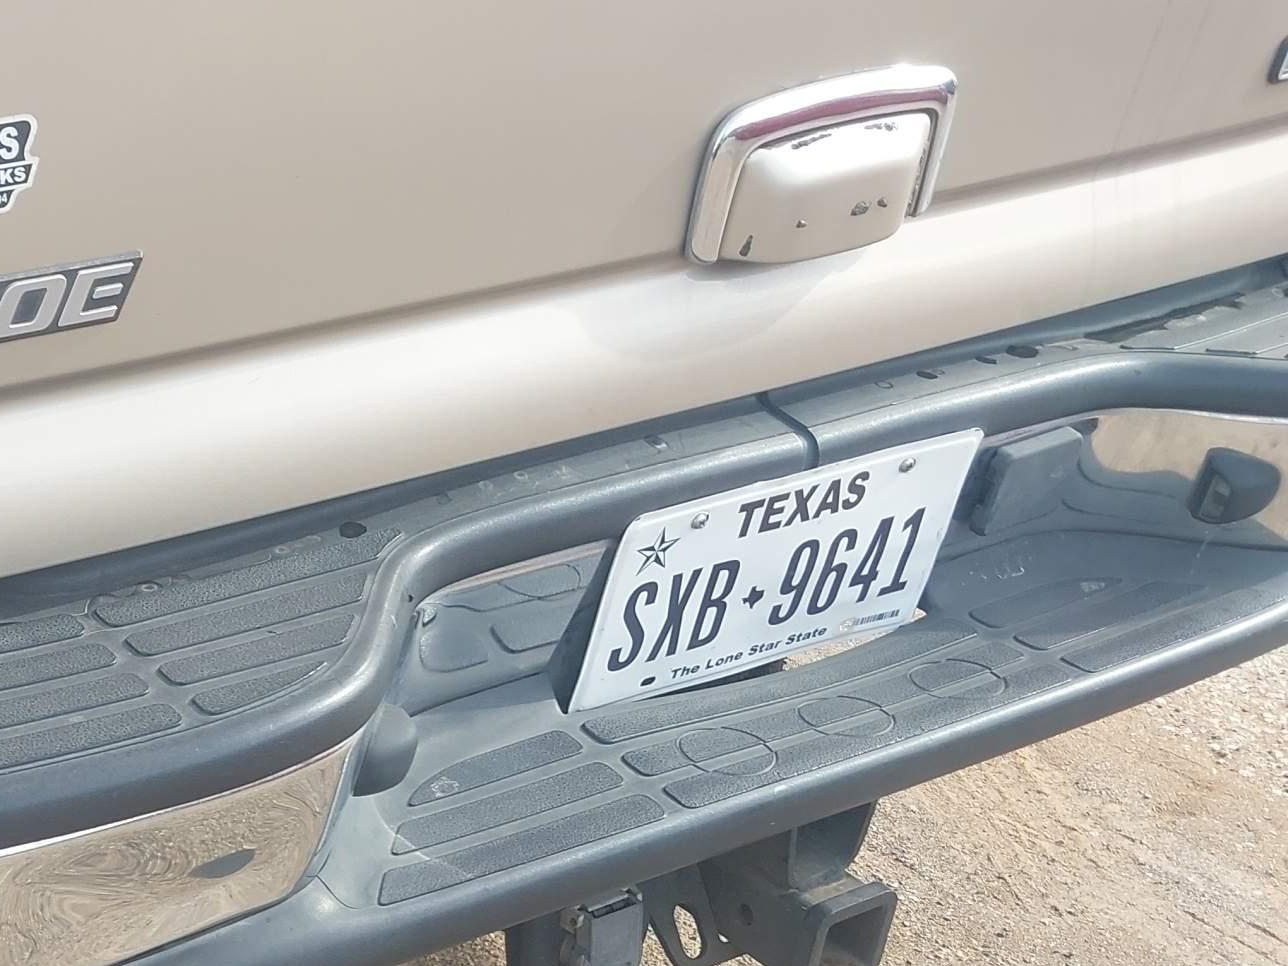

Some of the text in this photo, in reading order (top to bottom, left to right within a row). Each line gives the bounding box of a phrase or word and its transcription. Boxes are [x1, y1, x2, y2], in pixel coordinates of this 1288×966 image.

[736, 470, 872, 538] TEXAS
[607, 507, 926, 672] SXB 9641
[669, 625, 827, 680] The Lone Star State
